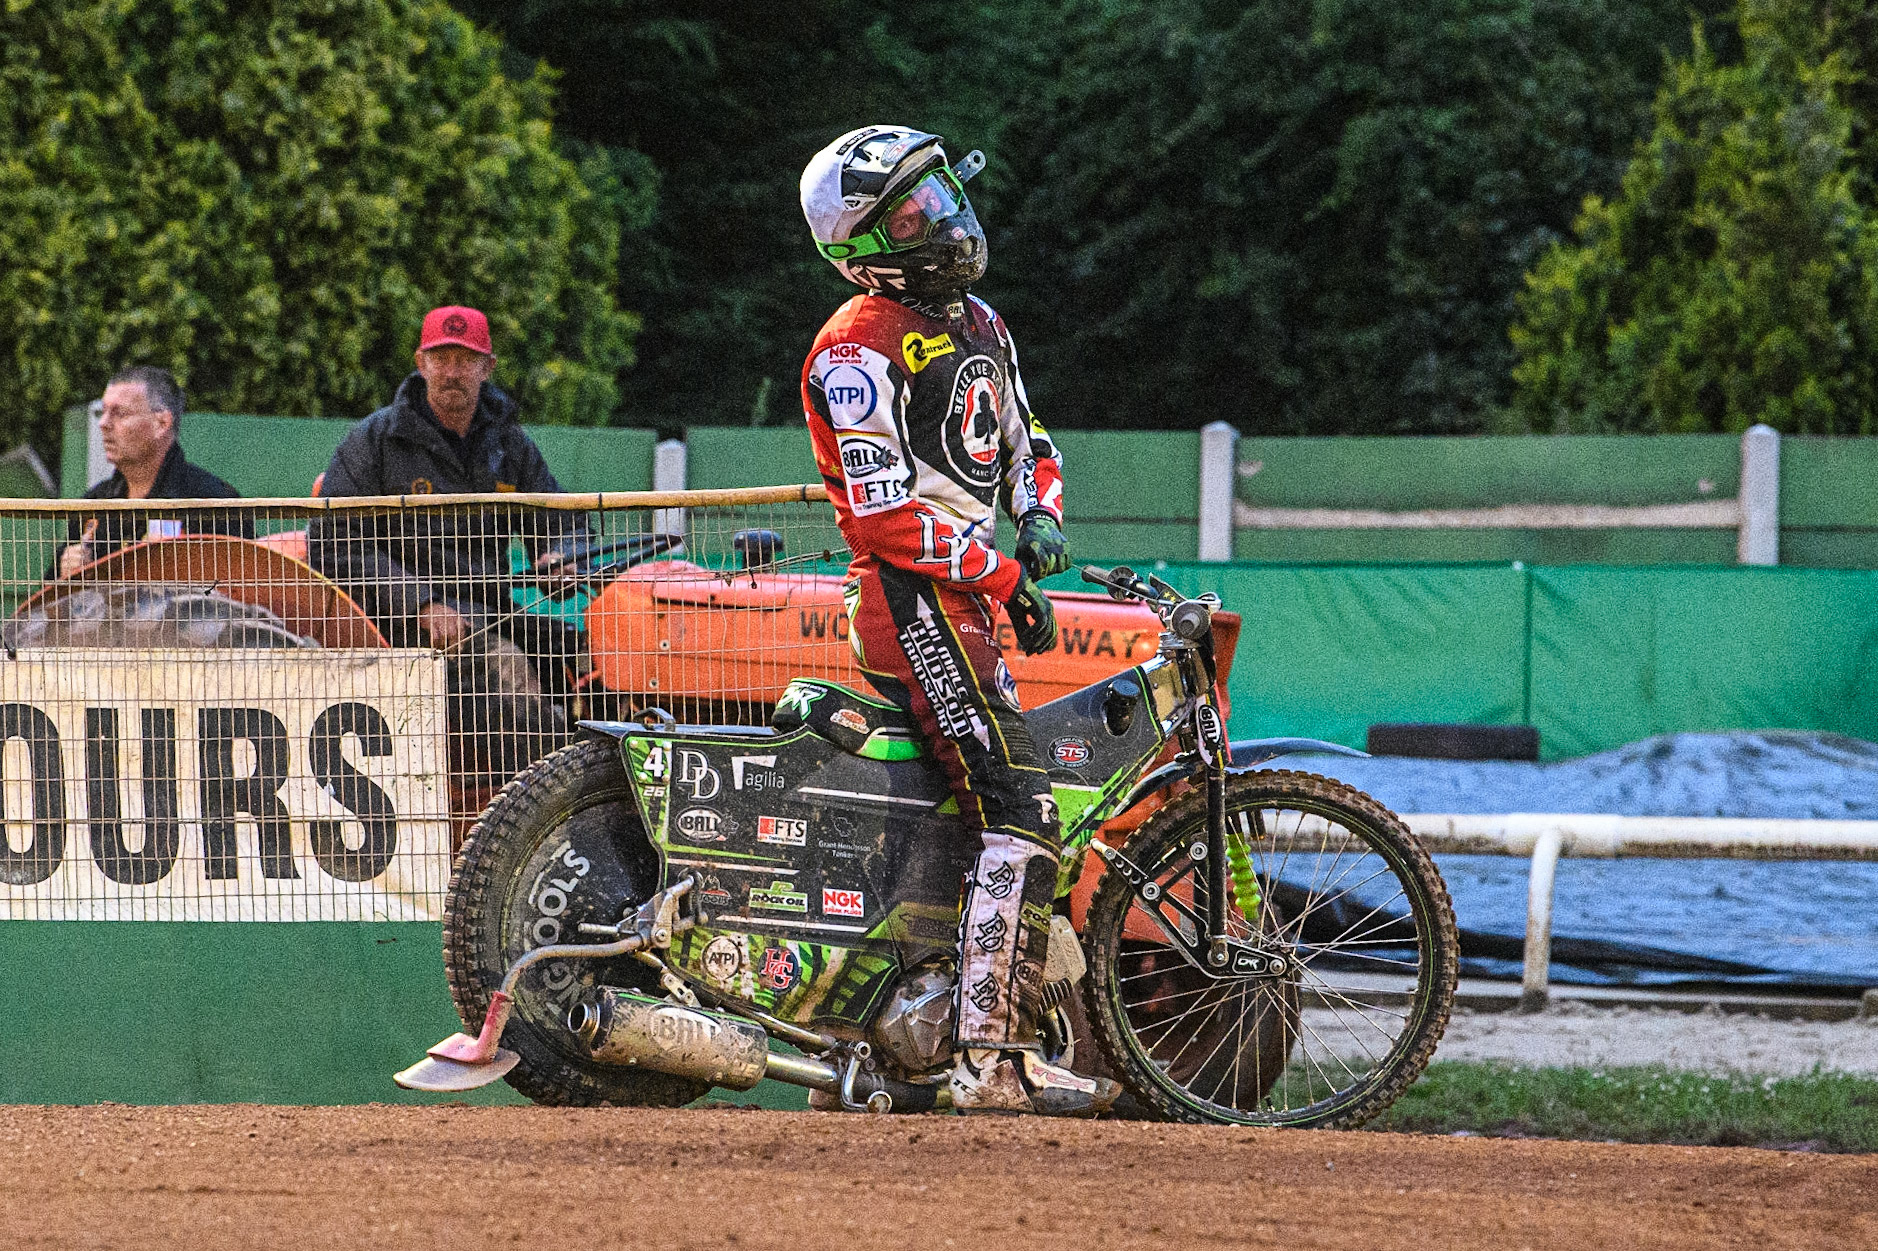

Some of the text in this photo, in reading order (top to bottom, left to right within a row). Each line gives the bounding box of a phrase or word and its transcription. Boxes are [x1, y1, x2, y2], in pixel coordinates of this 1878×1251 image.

[829, 345, 863, 359] NGK
[828, 387, 865, 405] ATPI
[954, 362, 988, 415] BELLE VUE
[864, 479, 901, 502] FTS
[907, 620, 973, 737] HUDSON
[937, 645, 970, 699] MALC
[899, 632, 953, 737] TRANSPORT
[643, 747, 665, 777] 4
[1055, 746, 1086, 759] STS
[677, 749, 721, 799] DD
[746, 767, 786, 790] agilia
[0, 702, 399, 885] OURS
[643, 785, 666, 797] 26
[776, 819, 805, 838] FTS
[751, 893, 806, 907] ROCK OIL
[824, 891, 862, 909] NGK
[708, 951, 735, 966] ATPI
